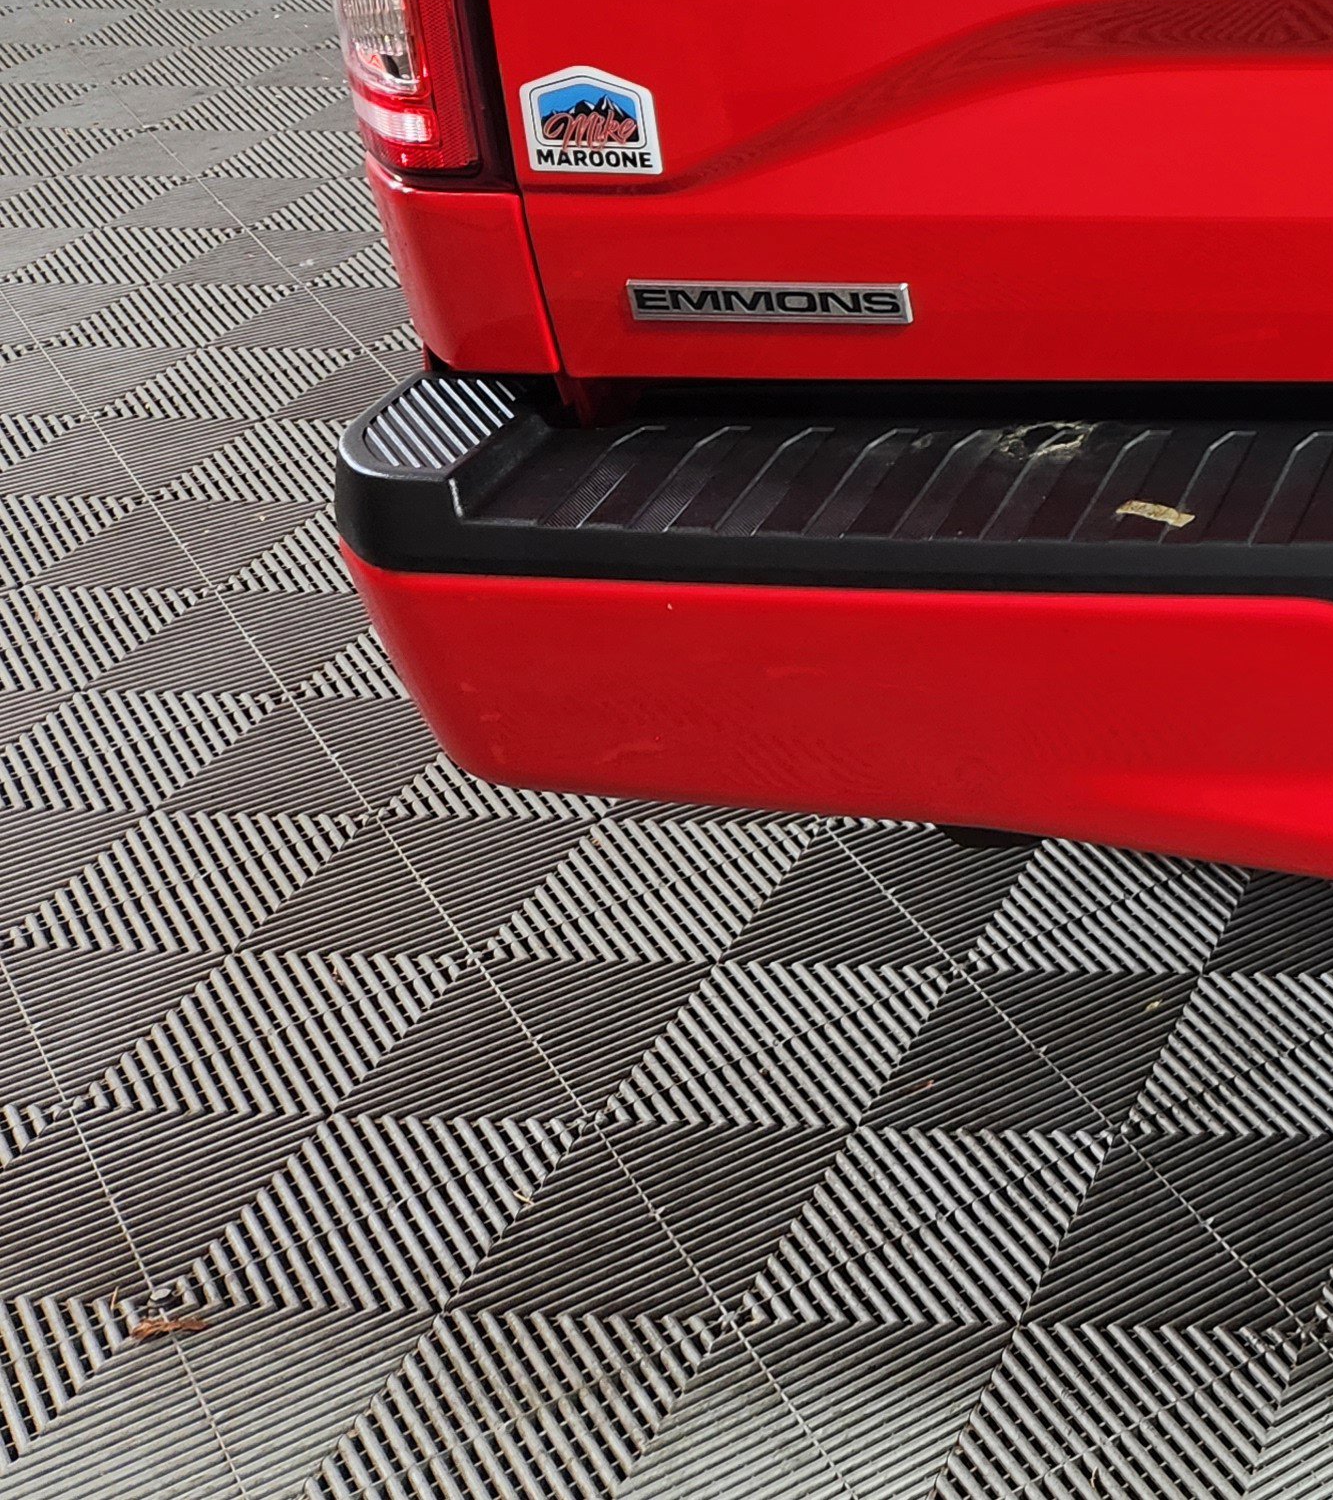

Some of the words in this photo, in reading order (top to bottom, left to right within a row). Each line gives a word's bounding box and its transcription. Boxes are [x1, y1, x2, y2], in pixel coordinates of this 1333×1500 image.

[544, 110, 637, 150] Mike
[536, 149, 653, 168] MAROONE
[633, 288, 901, 314] EMMONS
